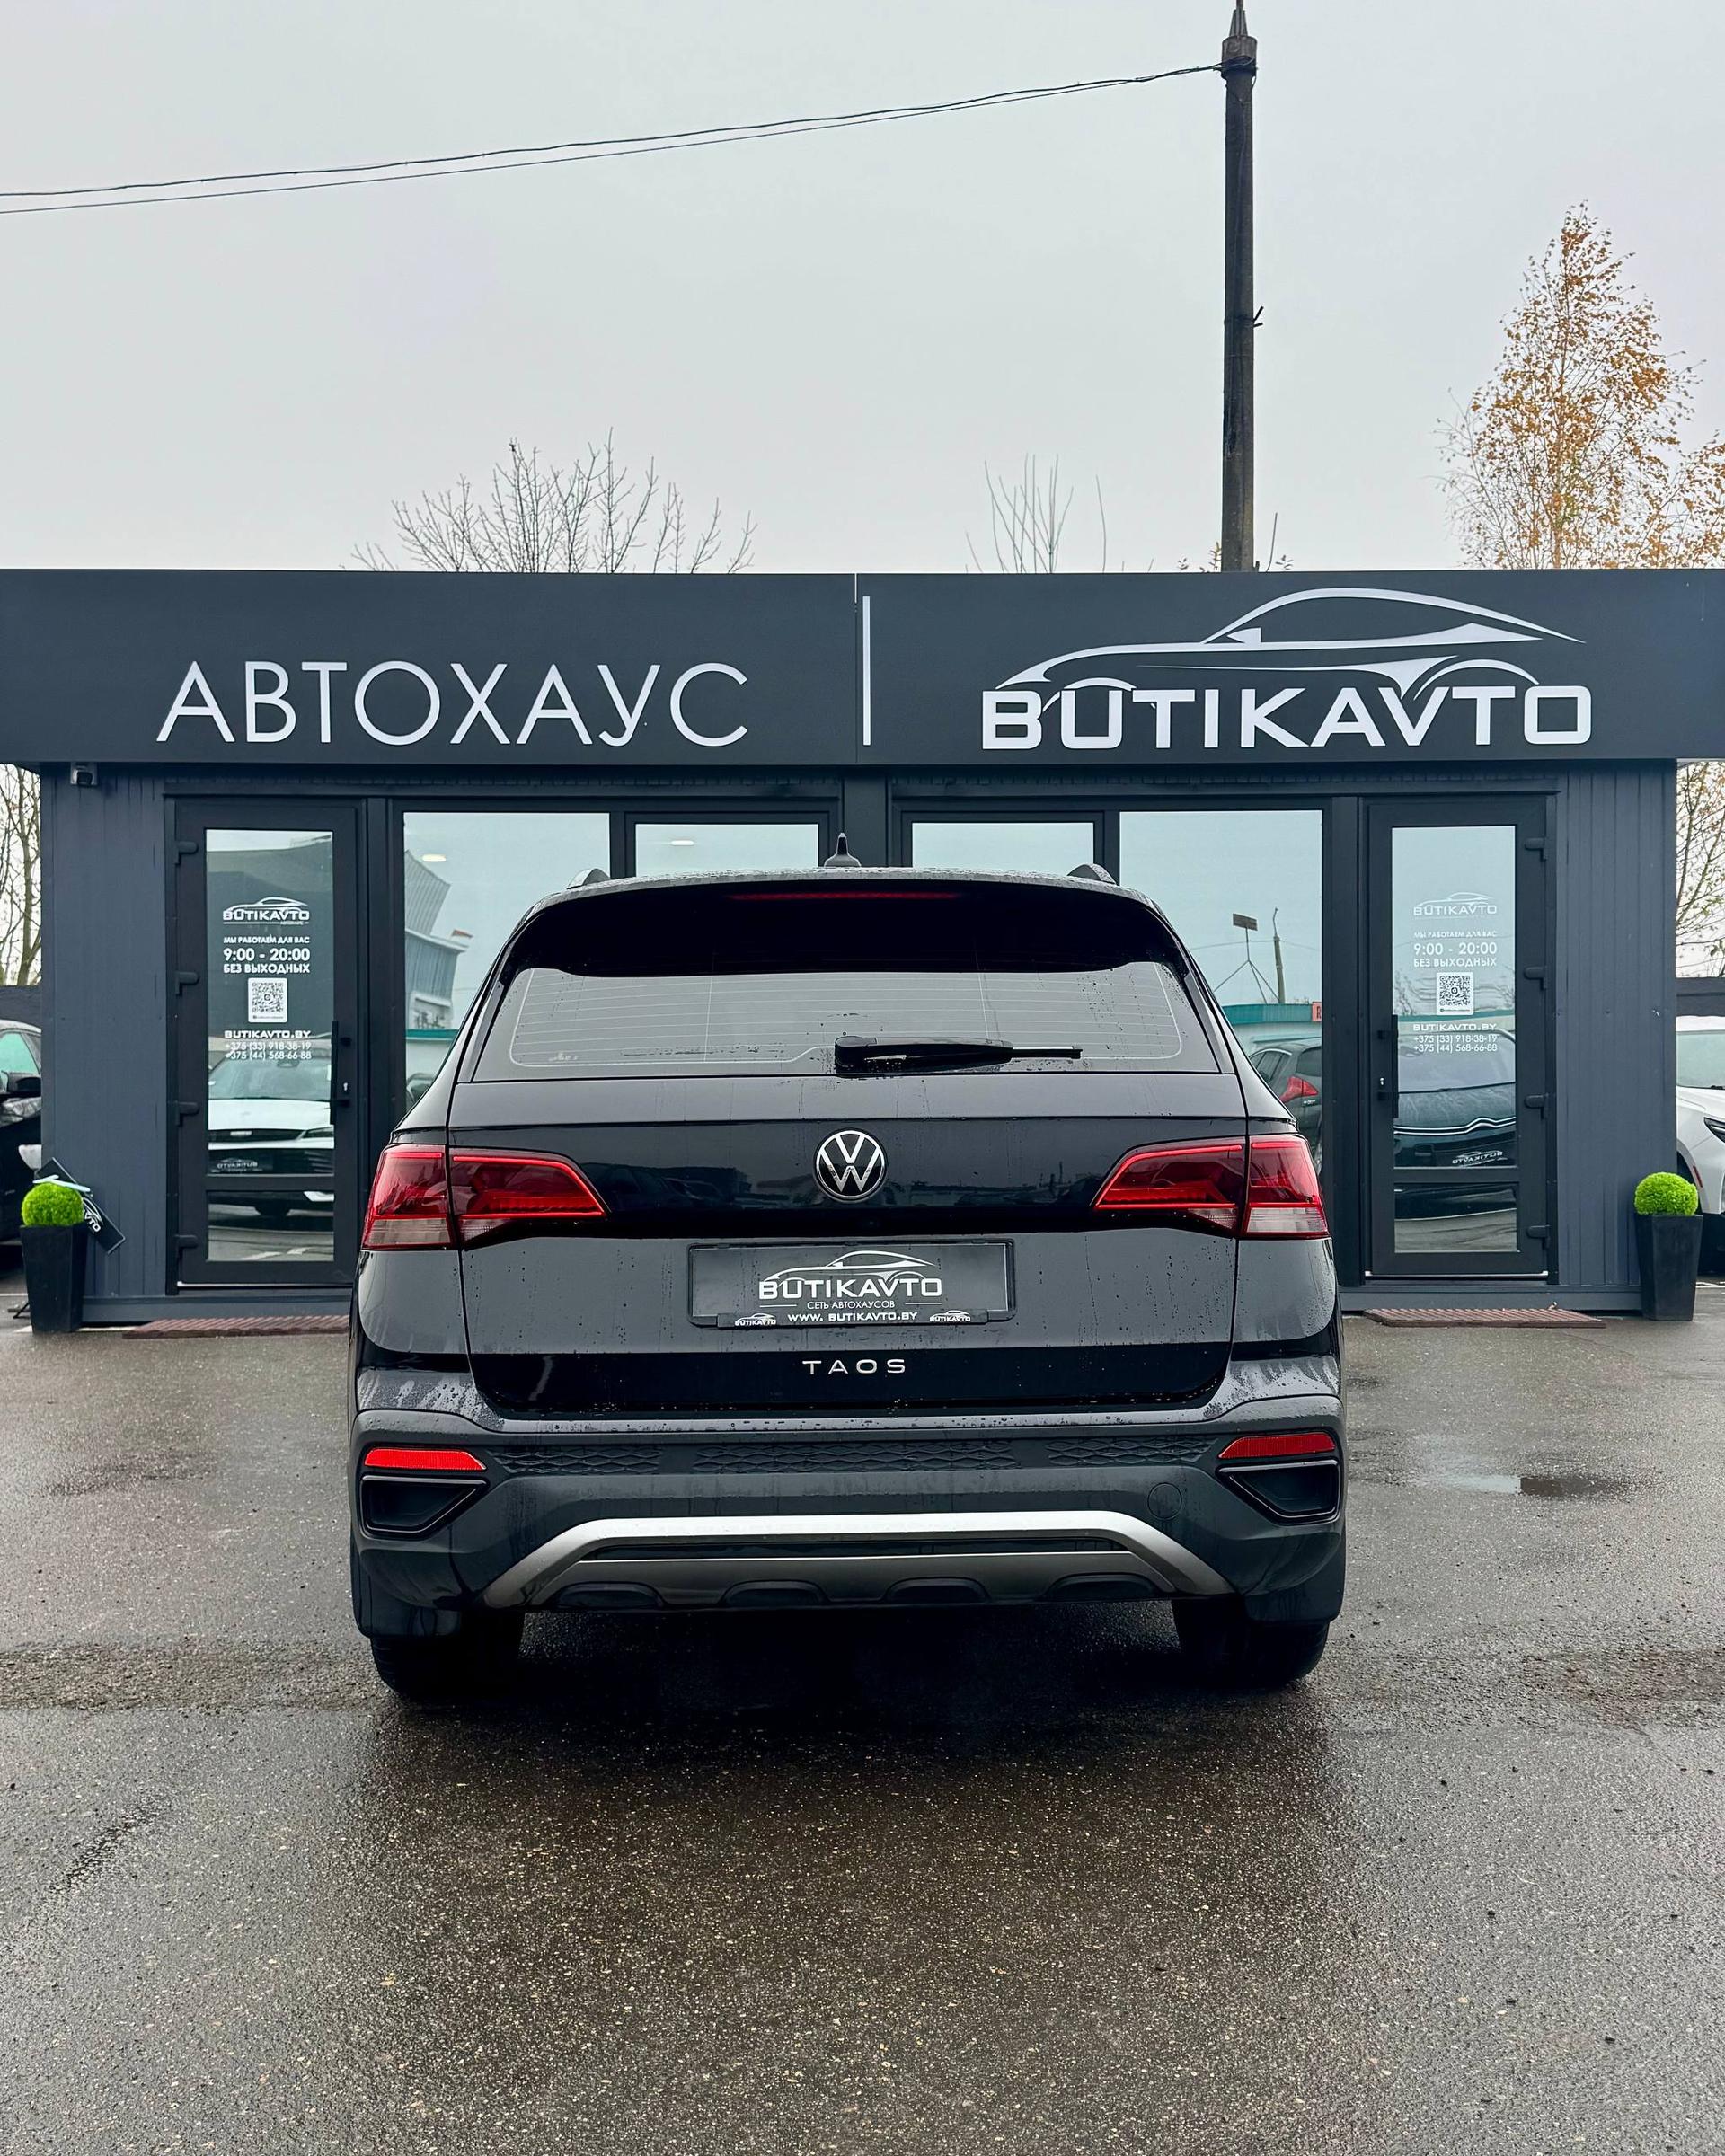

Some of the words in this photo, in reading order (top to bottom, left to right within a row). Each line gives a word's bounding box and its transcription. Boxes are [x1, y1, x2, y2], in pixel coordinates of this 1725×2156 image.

[156, 659, 748, 747] АВТОХАУС
[982, 685, 1591, 750] BUTIKAVTO
[1413, 905, 1497, 915] BUTIKAVTO
[223, 910, 310, 921] BUTIKAVTO
[1414, 943, 1444, 955] 9:00
[1459, 942, 1497, 955] 20:00
[223, 948, 255, 961] 9:00
[270, 948, 311, 961] 20:00
[1414, 958, 1430, 967] БЕЗ
[1434, 957, 1497, 968] ВЫХОДНЫХ
[223, 964, 242, 973] БЕЗ
[244, 963, 310, 974] ВЫХОДНЫХ
[1413, 1023, 1496, 1031] BUTIKAVTO.BY
[225, 1030, 311, 1038] BUTIKAVTO.BY
[1414, 1035, 1434, 1043] +375
[1437, 1035, 1453, 1045] (33)
[1455, 1035, 1497, 1043] 918-38-19
[249, 1042, 266, 1052] (33)
[1414, 1044, 1434, 1052] +375
[1437, 1043, 1453, 1053] (44)
[1455, 1043, 1497, 1052] 568-66-88
[249, 1051, 266, 1060] (44)
[269, 1050, 312, 1059] 568-66-88
[758, 1278, 942, 1300] BUTIKAVTO
[807, 1301, 829, 1310] СЕТЬ
[831, 1300, 896, 1309] АВТОХАУСОВ
[787, 1313, 824, 1322] WWW.
[828, 1312, 918, 1321] BUTIKAVTO.BY
[802, 1359, 907, 1374] TAOS
